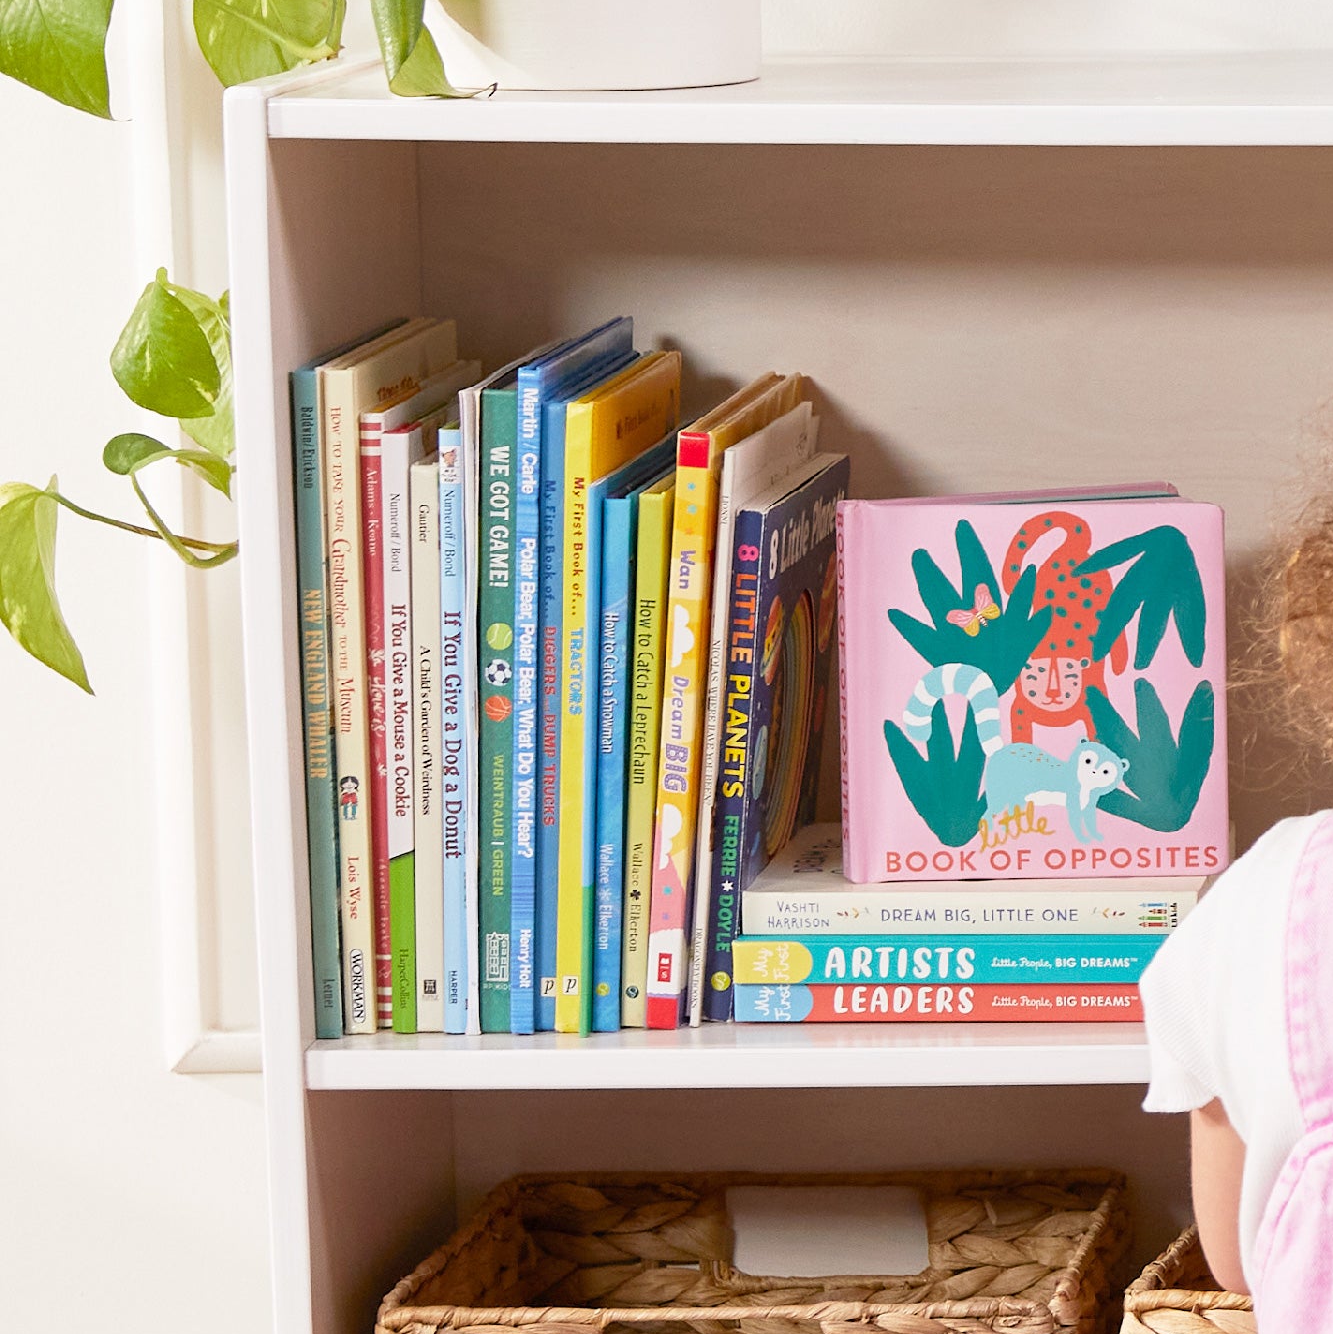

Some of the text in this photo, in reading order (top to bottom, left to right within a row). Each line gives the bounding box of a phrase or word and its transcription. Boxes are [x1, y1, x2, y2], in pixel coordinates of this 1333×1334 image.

[522, 388, 538, 438] Martin
[521, 452, 537, 494] Carle
[543, 480, 556, 502] My
[571, 477, 584, 498] My
[389, 493, 402, 539] Numeroff
[418, 504, 430, 543] Gautier
[443, 489, 456, 538] Numeroff
[488, 446, 510, 588] WE GOT GAME!
[544, 505, 556, 540] First
[572, 503, 584, 536] First
[444, 549, 456, 577] Bond
[544, 545, 556, 581] Book
[572, 542, 584, 577] Book
[769, 528, 779, 580] 8
[780, 510, 811, 573] Little
[330, 538, 352, 627] Grandmother
[678, 549, 697, 590] Wan
[604, 612, 618, 637] How
[604, 640, 616, 652] to
[303, 589, 327, 779] NEW ENGLAND WHALER
[543, 626, 557, 696] DIGGERS
[569, 627, 584, 716] TRACTORS
[603, 655, 618, 687] Catch
[721, 544, 759, 798] 8 LITTLE PLANETS
[836, 513, 850, 840] BOOK OF OPPOSITES
[391, 604, 409, 818] If You Give a Mouse a Cookie
[517, 538, 537, 858] Polar Bear, Polar Bear, What Do You Hear?
[632, 599, 656, 785] How to Catch a Leprechaun
[419, 645, 433, 816] A Child's Garden of Weirdness
[442, 611, 463, 859] If You Give a Dog a Donut
[543, 714, 556, 759] DUMP
[601, 698, 615, 753] Snowman
[662, 675, 690, 792] Dream BIG
[543, 765, 556, 826] TRUCKS
[491, 754, 505, 896] WEINTRAUB GREEN
[978, 801, 1055, 853] little
[886, 846, 1219, 873] BOOK OF OPPOSITES
[347, 857, 361, 920] Lois Wyse
[598, 844, 614, 950] Wallace Elkerton
[628, 843, 644, 952] Wallace Elkerton
[714, 815, 740, 953] FERRIE DOYLE
[768, 916, 830, 929] HARRISON
[776, 902, 820, 914] VASHTI
[881, 908, 1079, 924] DREAM BIG, LITTLE ONE
[398, 949, 410, 1009] HarperCollins
[516, 929, 532, 988] Henry Holt
[752, 947, 774, 978] My
[773, 942, 790, 982] First
[825, 946, 976, 979] ARTISTS
[991, 956, 1018, 968] Little
[1019, 956, 1053, 972] People,
[1055, 957, 1077, 968] BIG
[352, 952, 364, 1019] WORKMAN
[449, 970, 458, 1005] HARPER
[754, 986, 776, 1017] My
[775, 984, 792, 1021] First
[833, 985, 975, 1015] LEADERS
[991, 995, 1018, 1007] Little
[1020, 995, 1053, 1011] People,
[1055, 996, 1077, 1007] BIG
